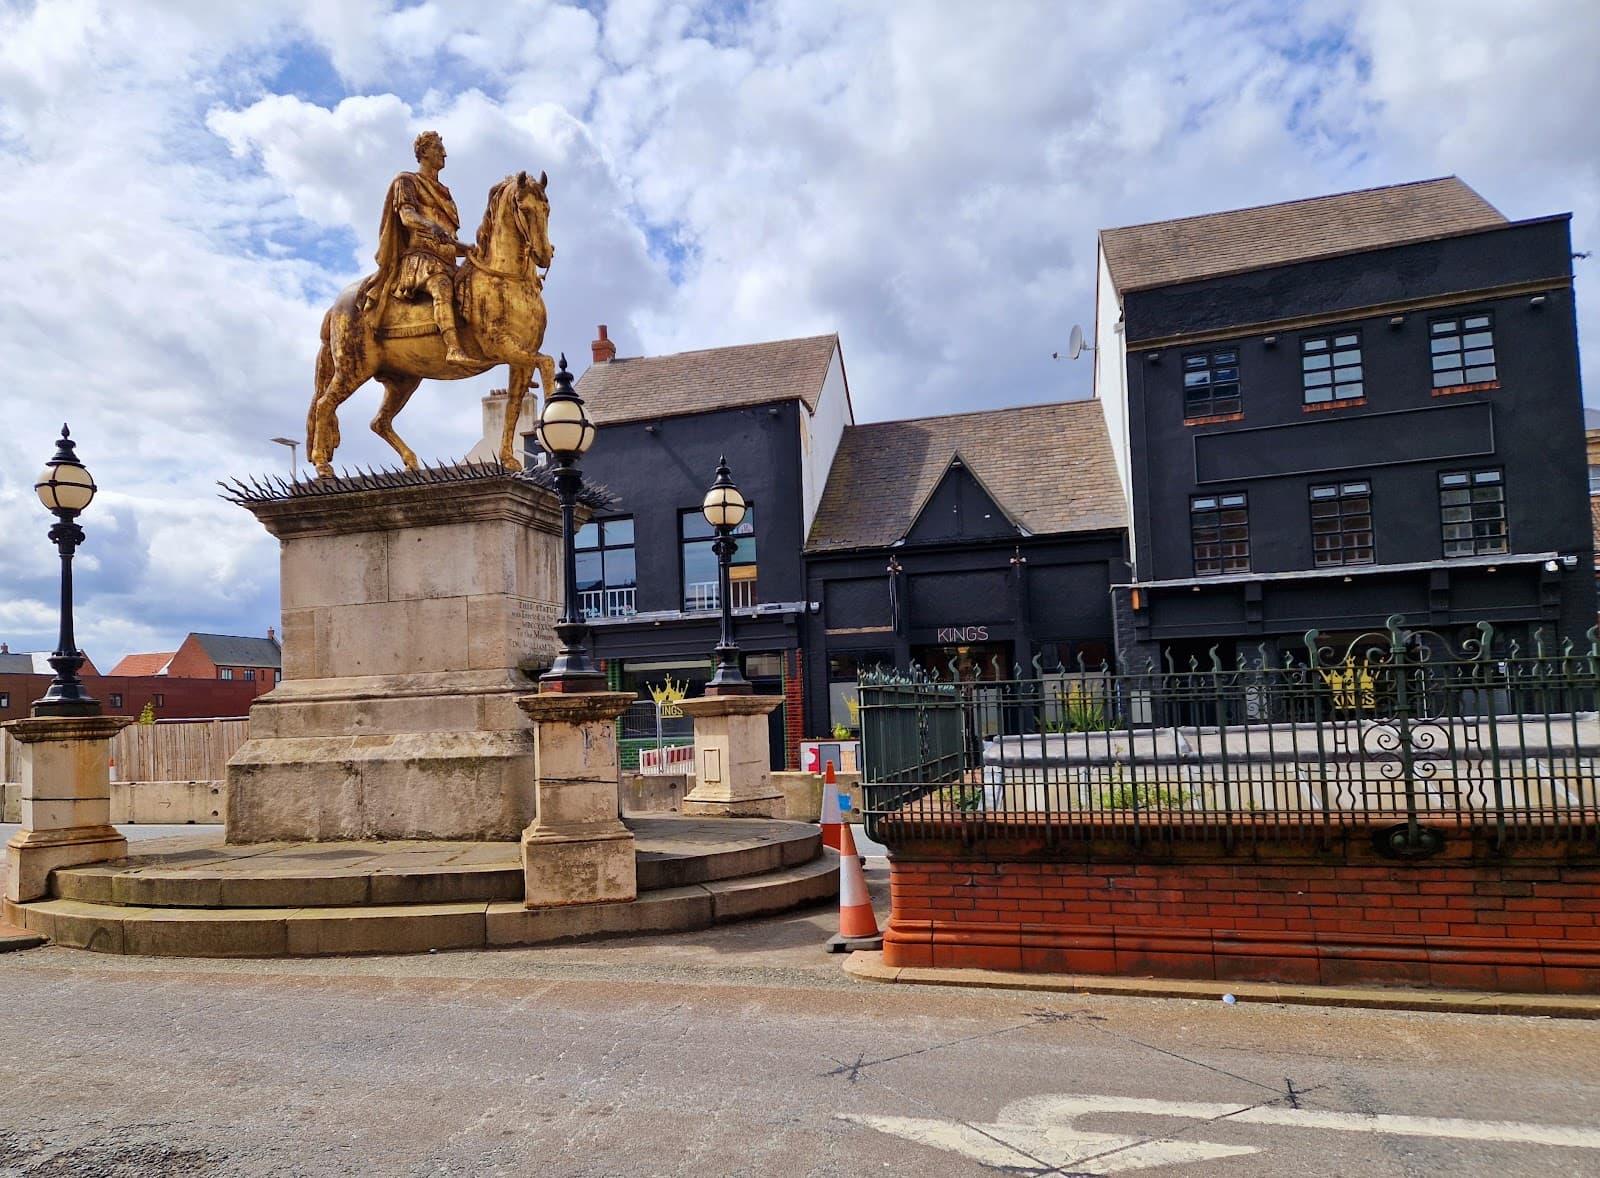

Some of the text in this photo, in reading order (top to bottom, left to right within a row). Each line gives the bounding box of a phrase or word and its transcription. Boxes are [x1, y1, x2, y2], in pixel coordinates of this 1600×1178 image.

[536, 604, 558, 615] STATUE
[937, 625, 989, 643] KINGS
[1332, 691, 1376, 706] KINS
[661, 705, 684, 716] INGS
